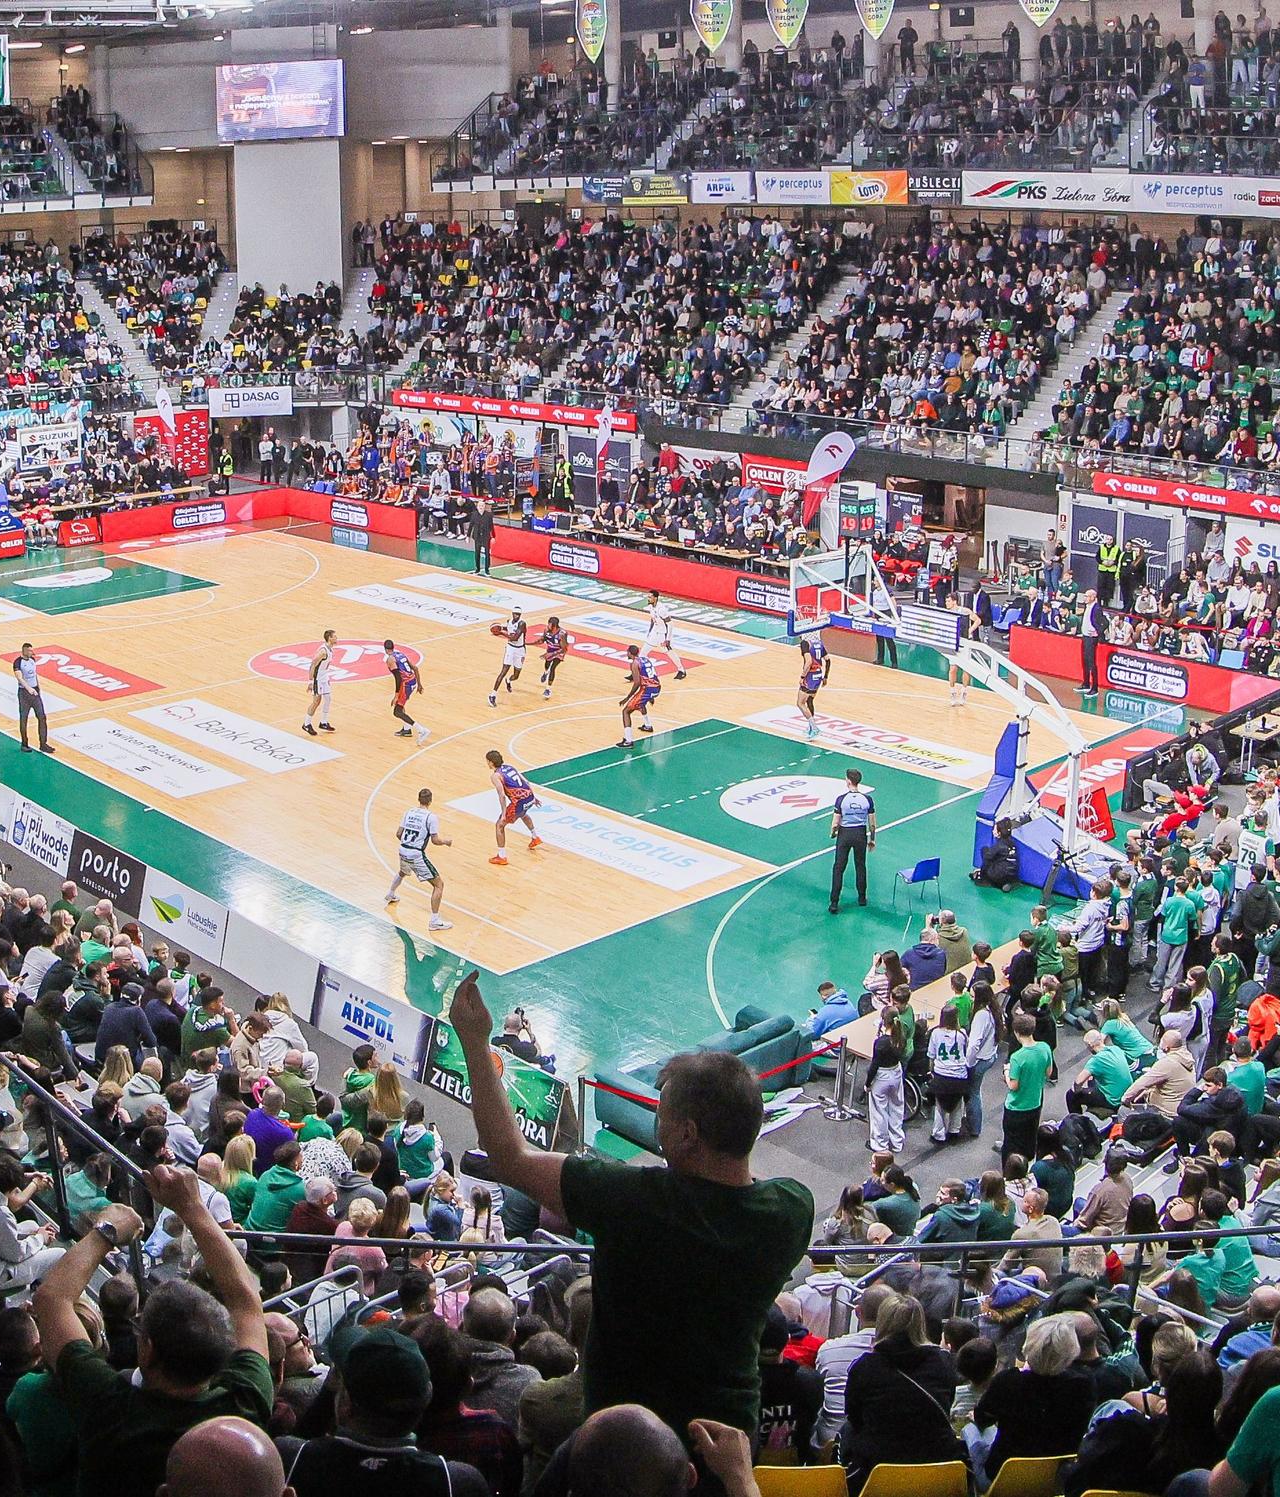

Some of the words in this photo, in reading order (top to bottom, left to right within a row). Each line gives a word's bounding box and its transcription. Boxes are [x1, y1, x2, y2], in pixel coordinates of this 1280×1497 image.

[706, 183, 735, 192] ARPOL
[779, 178, 822, 189] perceptus
[858, 184, 879, 197] LOTTO
[1165, 184, 1223, 198] perceptus
[1017, 186, 1047, 199] PKS
[1052, 186, 1096, 201] Zielona
[1102, 187, 1131, 203] Góra
[1233, 192, 1256, 202] radio
[242, 391, 280, 402] DASAG
[564, 411, 585, 421] ORLEN
[39, 431, 73, 442] SUZUKI
[749, 468, 782, 484] ORLEN
[1123, 482, 1157, 495] ORLEN
[1192, 492, 1226, 505] ORLEN
[841, 504, 857, 514] 9:55
[860, 505, 874, 514] 9:55
[175, 516, 199, 526] ORLEN
[842, 517, 857, 530] 19
[861, 516, 874, 530] 19
[1, 538, 23, 549] ORLEN
[551, 554, 574, 565] ORLEN
[739, 579, 763, 592] Oficjalny
[764, 584, 790, 597] Menedże
[739, 591, 765, 604] ORLEN
[1112, 655, 1145, 671] Oficjalny
[1147, 661, 1183, 677] Menedżer
[61, 665, 131, 692] ORLEN
[1111, 670, 1145, 685] ORLEN
[791, 713, 910, 744] BRICO
[195, 720, 244, 742] Bank
[242, 737, 306, 766] Pekao
[512, 774, 522, 787] 7
[732, 779, 808, 806] SUZUKI
[29, 813, 43, 835] pij
[41, 833, 68, 861] wodę
[404, 828, 420, 843] 77
[545, 813, 699, 868] perceptus
[31, 838, 59, 869] kranu
[1241, 848, 1257, 865] 79
[80, 848, 130, 888] posto
[82, 876, 118, 900] DEVELOPMENT
[187, 907, 218, 932] Lubuskie
[341, 1001, 394, 1044] ARPOL
[938, 1042, 961, 1061] 44
[430, 1067, 472, 1104] ZIELO
[514, 1109, 547, 1147] ÓRA
